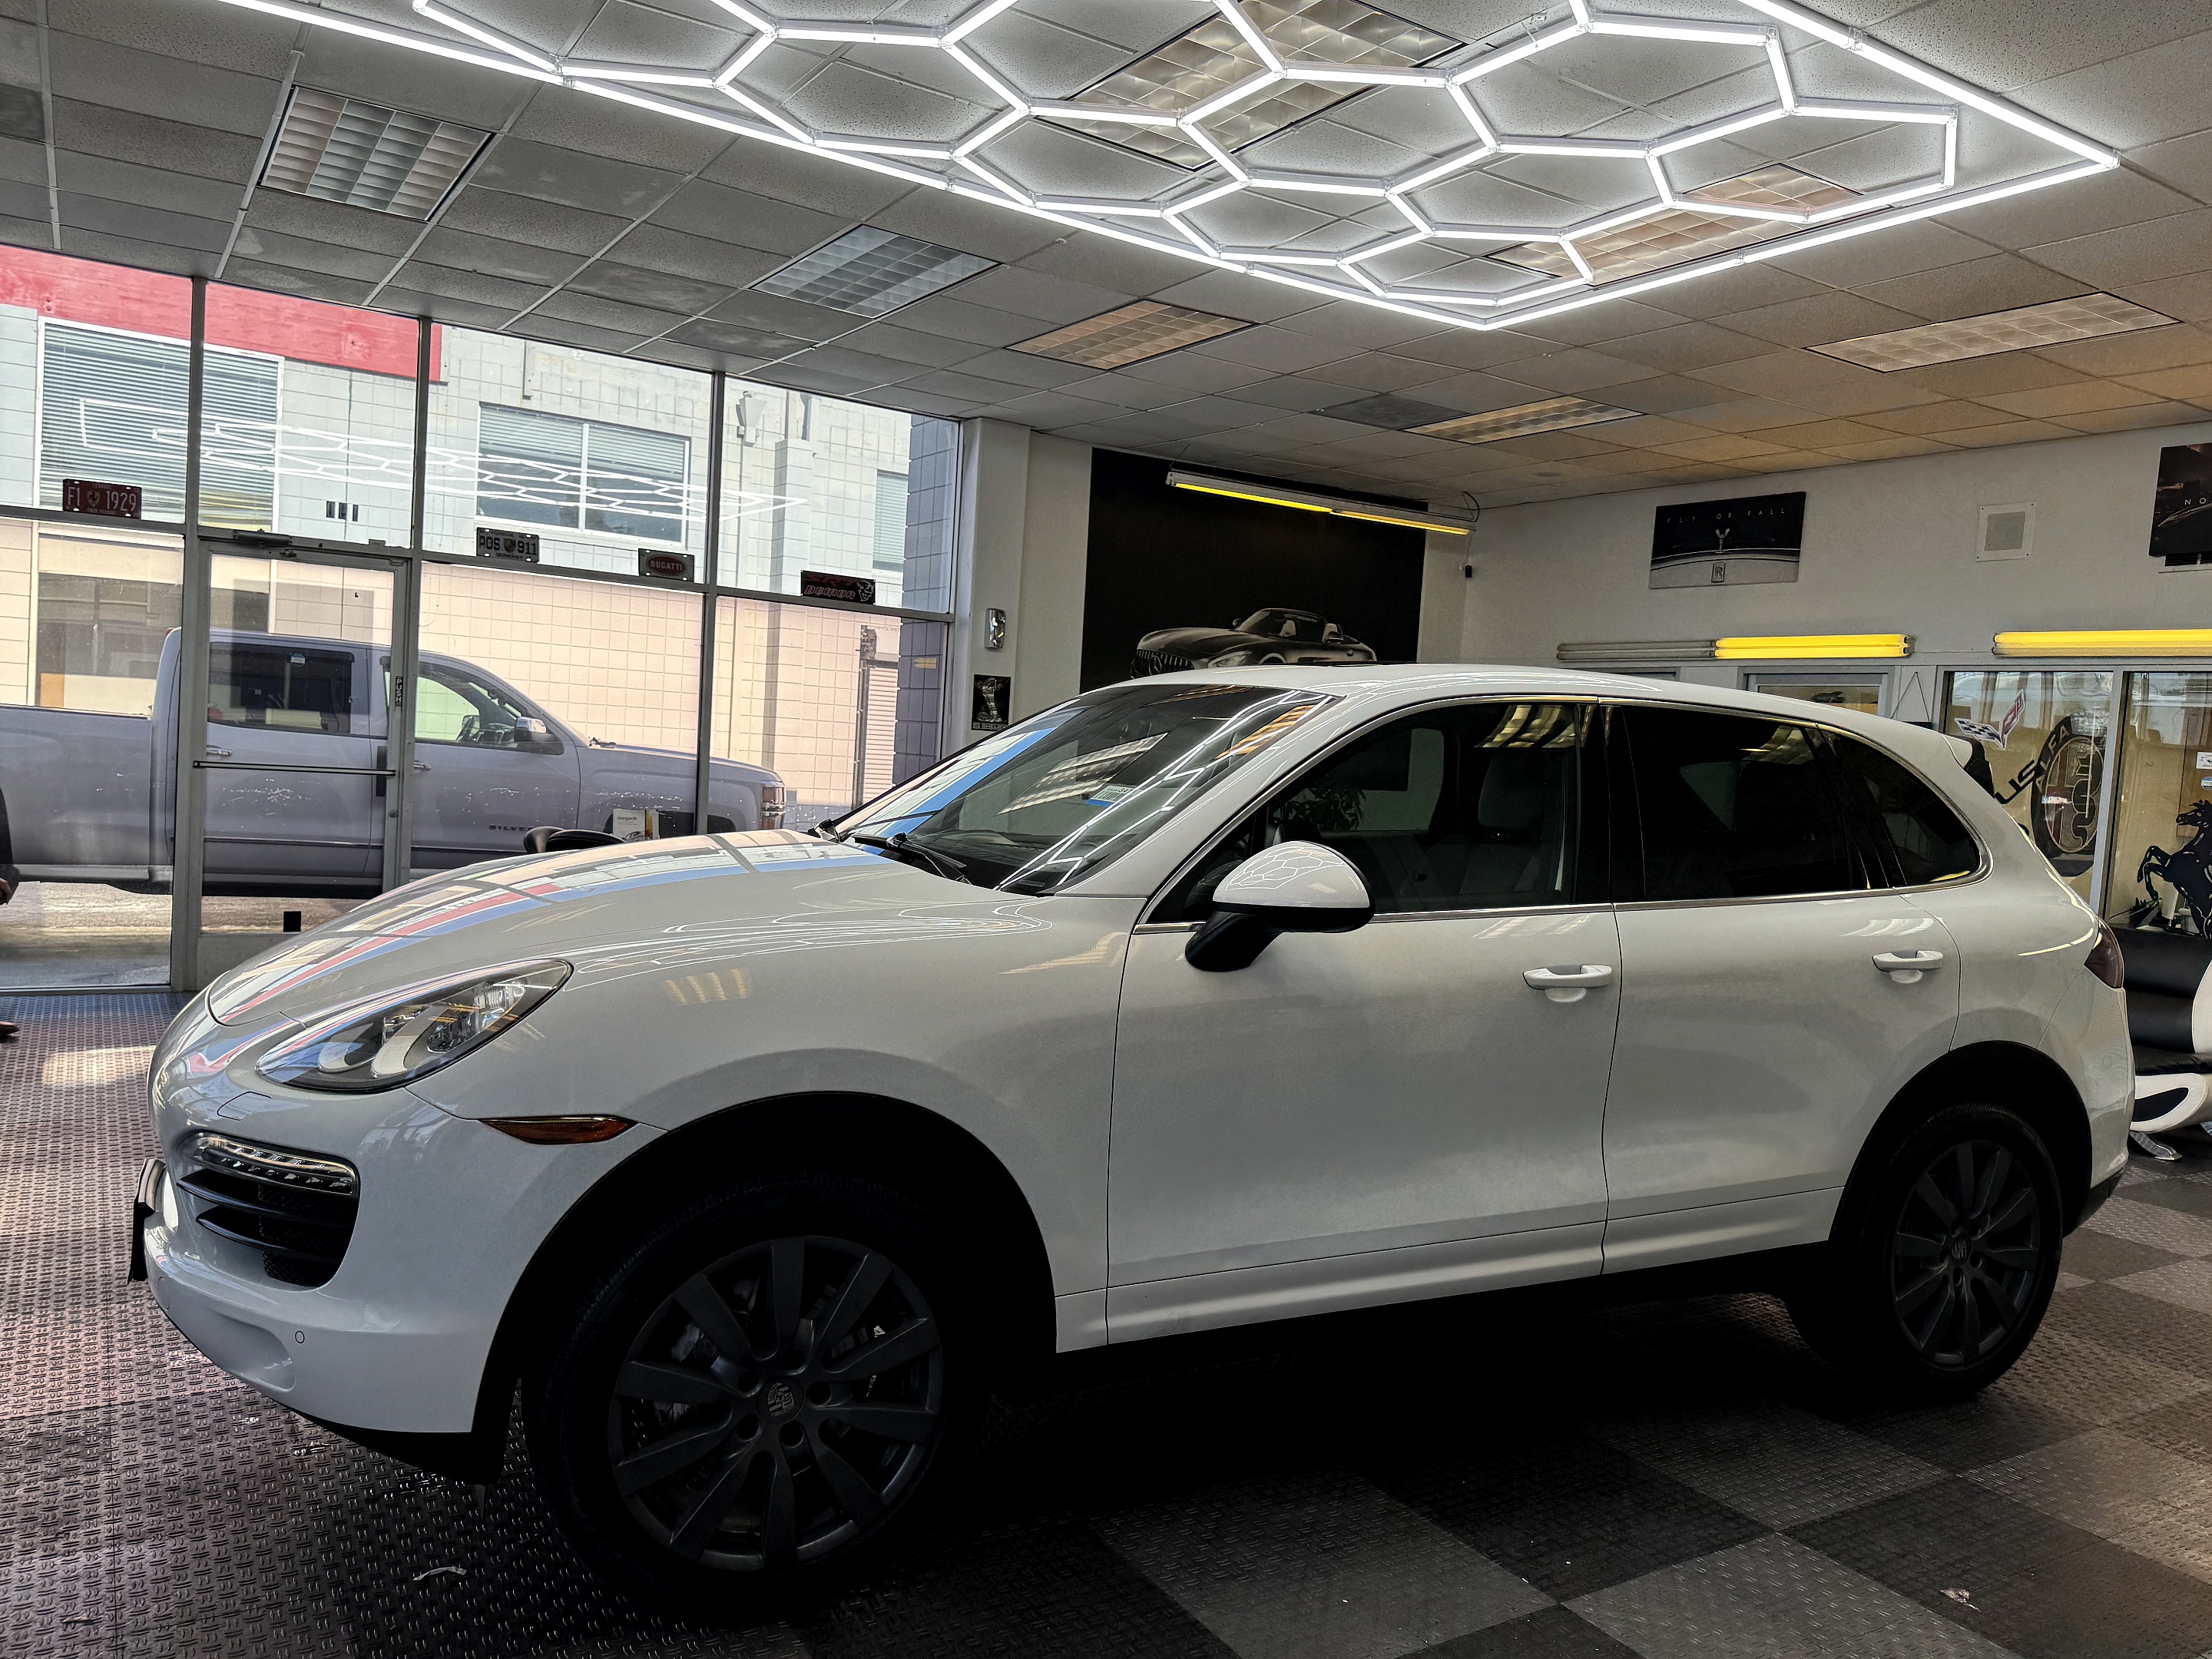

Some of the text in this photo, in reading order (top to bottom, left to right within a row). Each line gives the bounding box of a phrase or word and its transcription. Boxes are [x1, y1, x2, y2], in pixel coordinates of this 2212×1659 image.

[67, 486, 137, 512] F1 1929
[1747, 508, 1785, 517] FALL
[478, 535, 538, 555] POS 911
[650, 560, 683, 571] BUGATTI
[803, 573, 863, 588] SRT
[2035, 724, 2070, 793] ALFA
